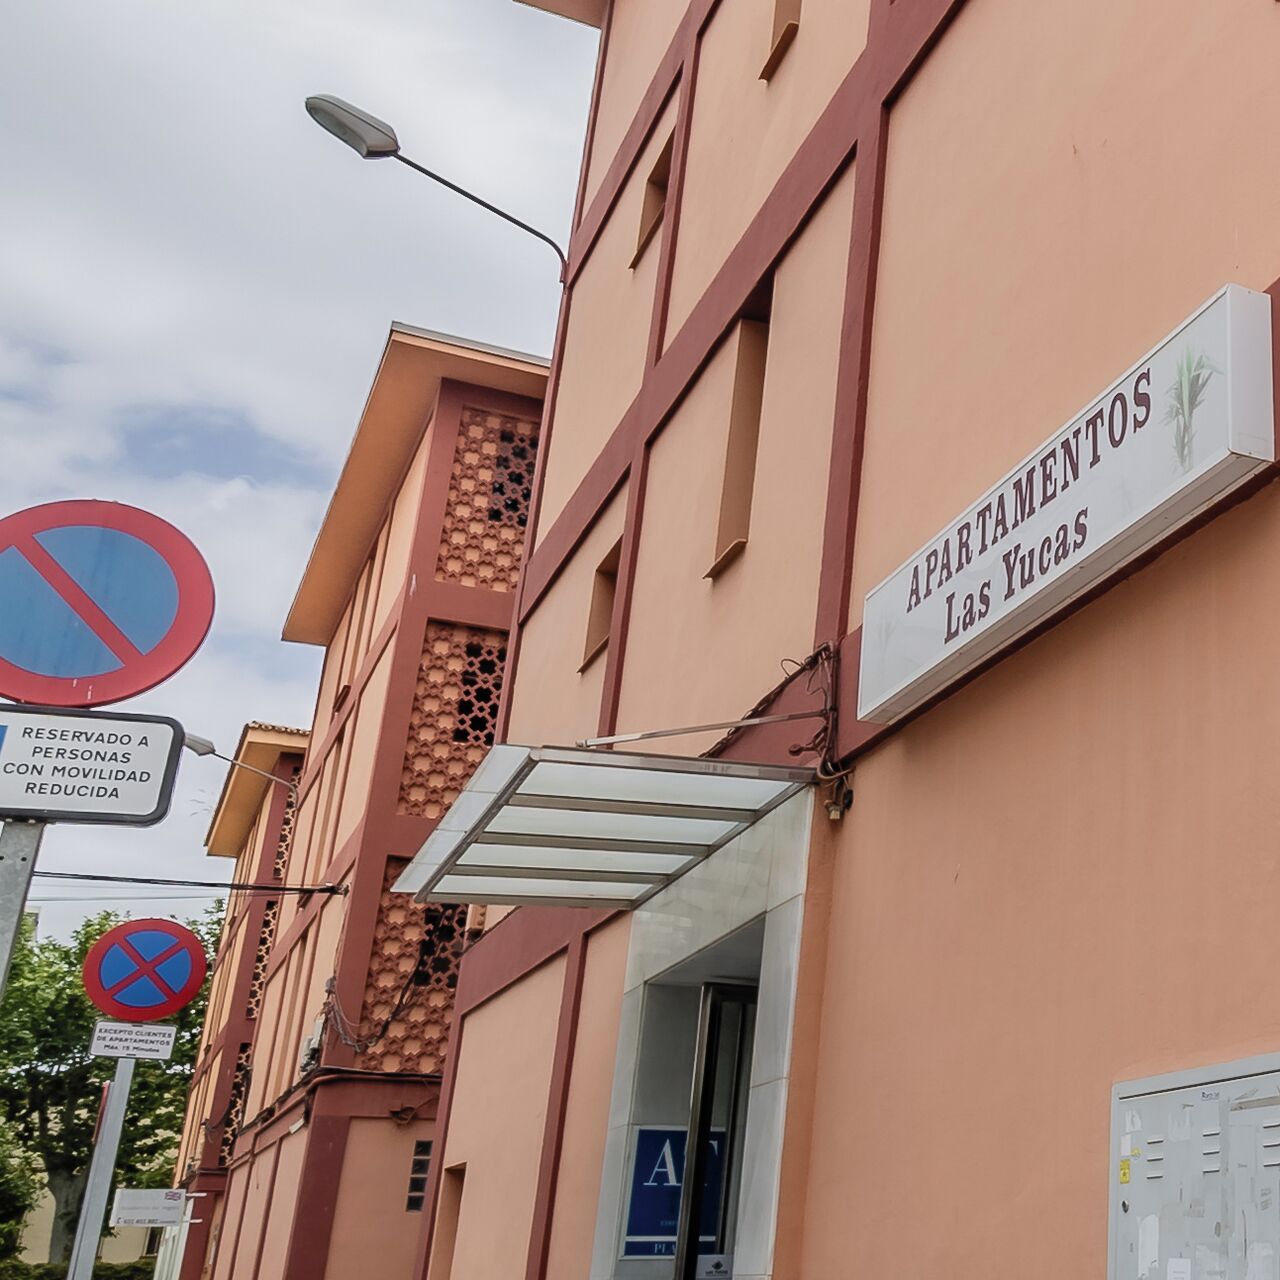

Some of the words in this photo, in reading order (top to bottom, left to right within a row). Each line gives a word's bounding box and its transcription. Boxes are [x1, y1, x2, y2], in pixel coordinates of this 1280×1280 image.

[906, 367, 1152, 614] APARTAMENTOS
[943, 579, 992, 645] Las
[1003, 507, 1089, 601] Yucas
[22, 727, 132, 746] RESERVADO
[137, 736, 149, 747] A
[32, 746, 132, 764] PERSONAS
[3, 762, 44, 776] CON
[51, 765, 151, 783] MOVILIDAD
[25, 782, 119, 799] REDUCIDA
[98, 1028, 133, 1036] EXCEPTO
[135, 1030, 172, 1038] CLIENTES
[109, 1036, 170, 1046] APARTAMENTOS
